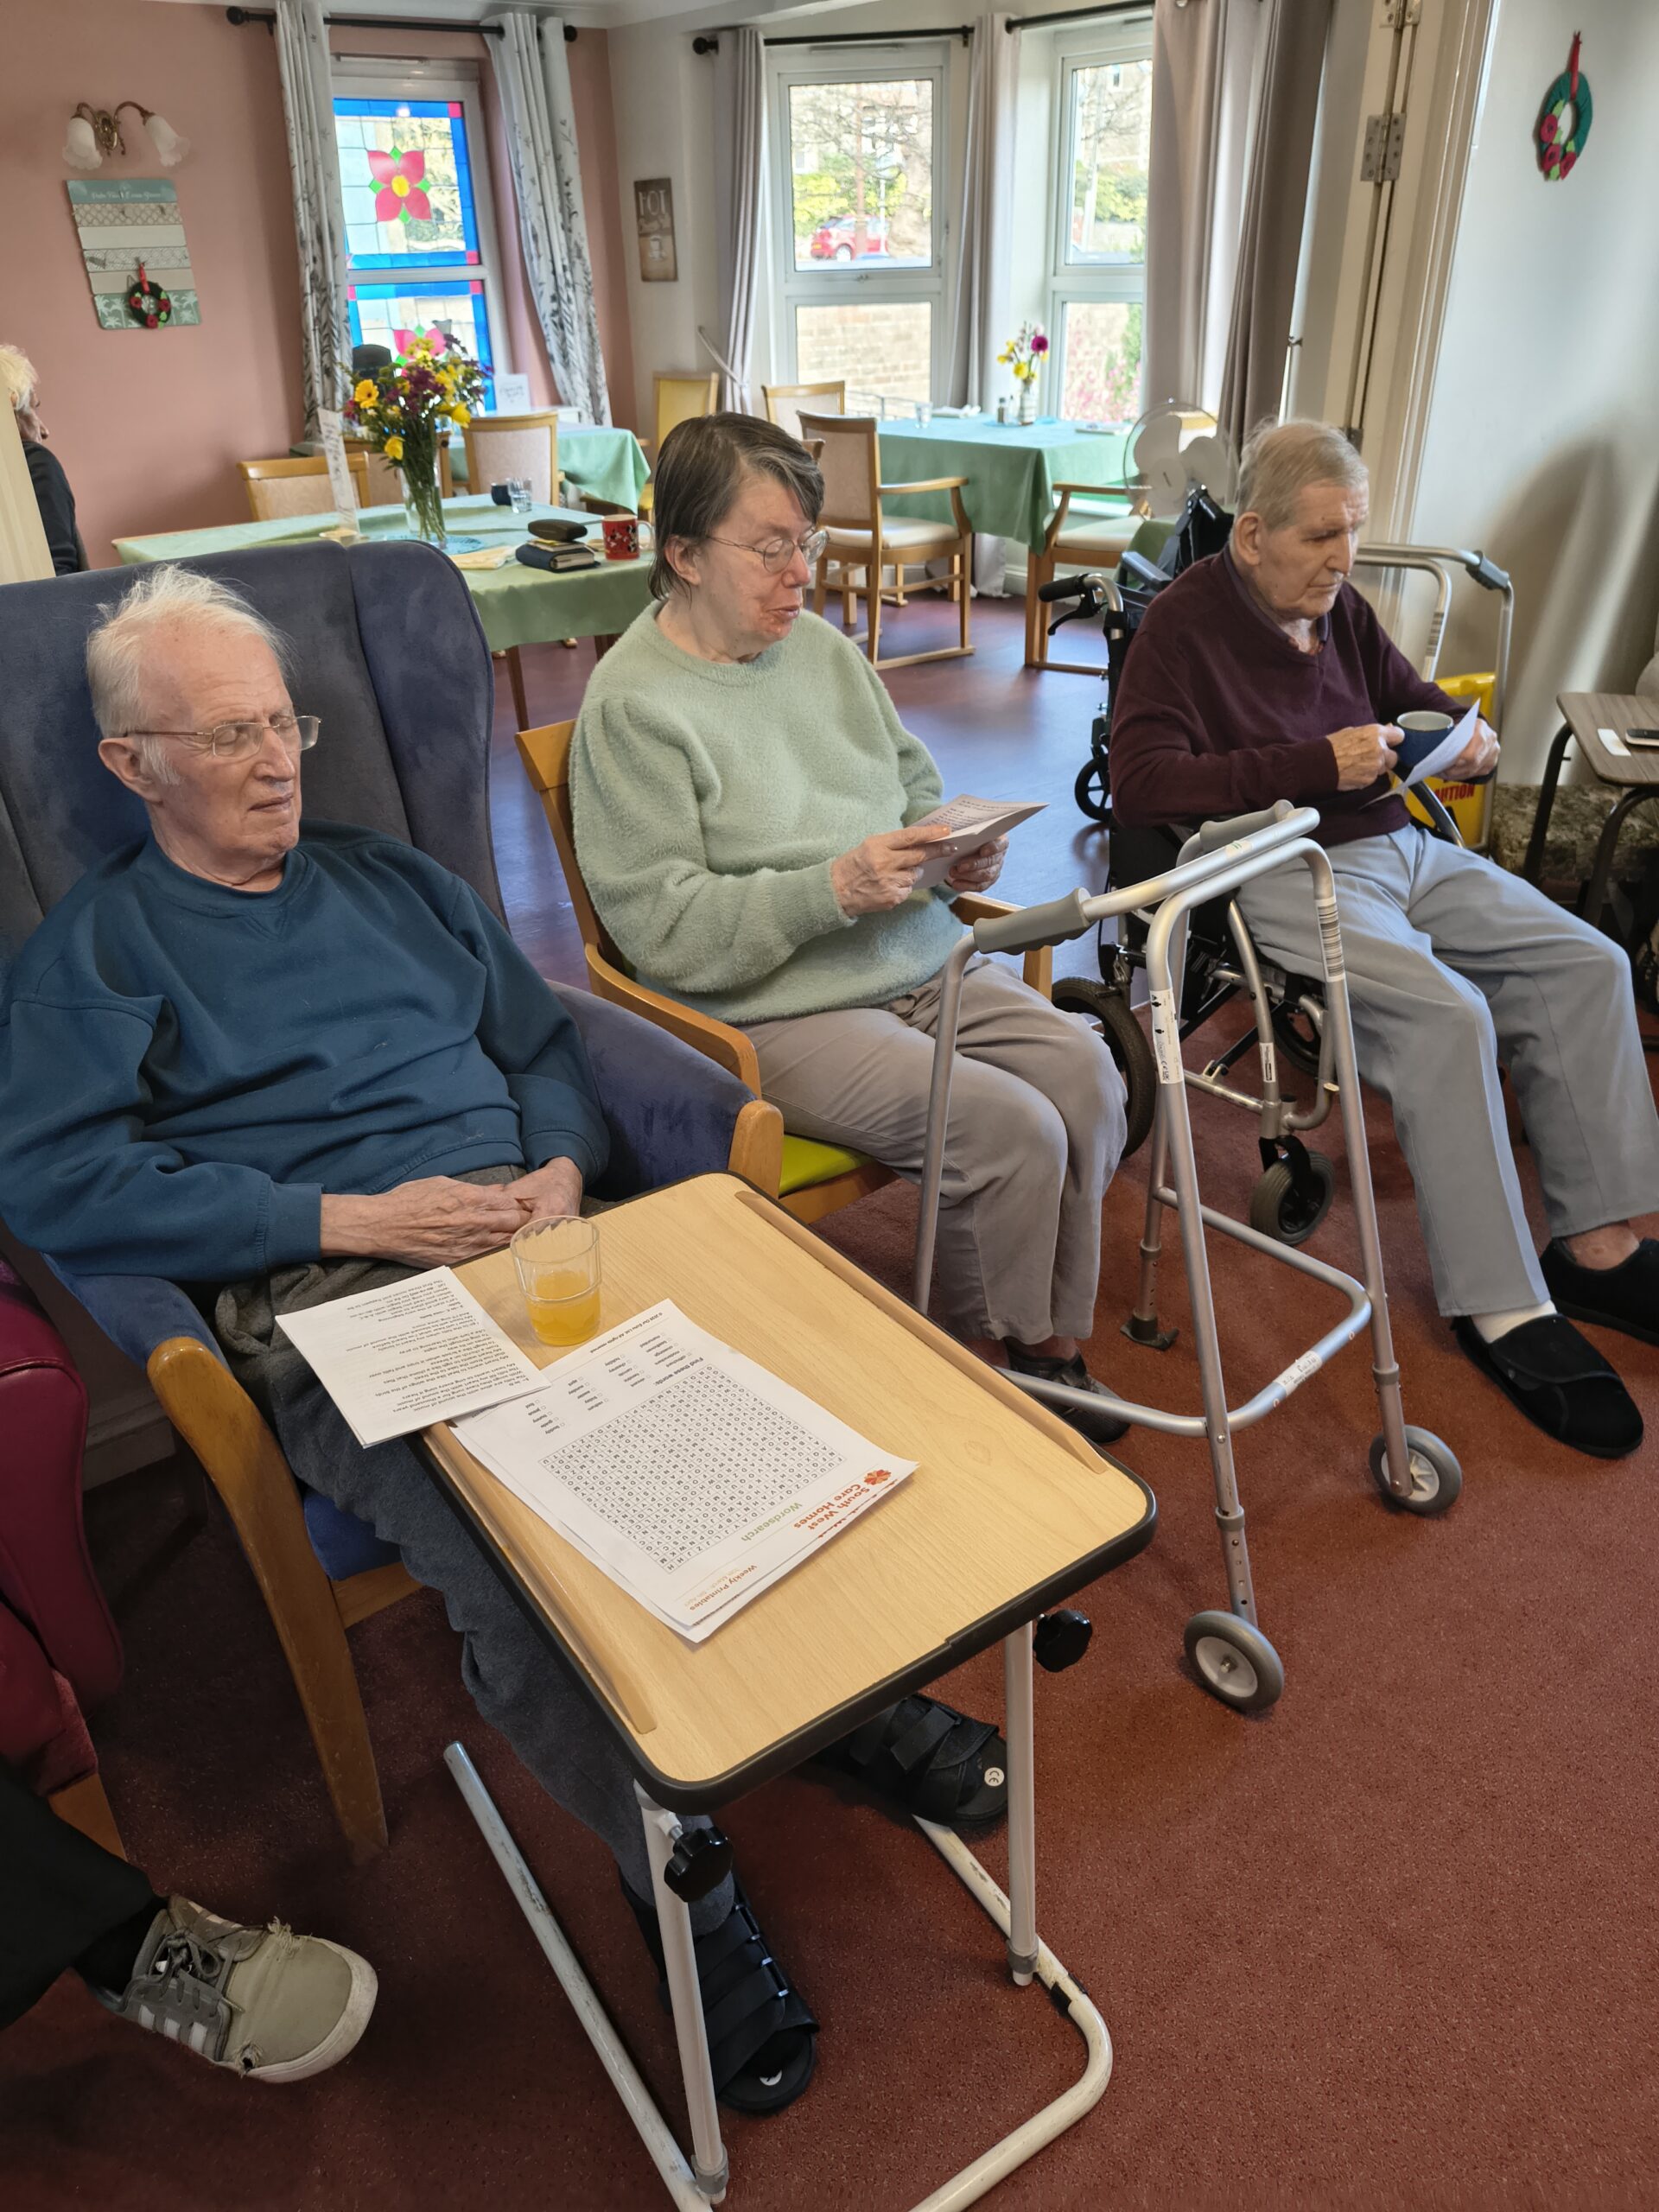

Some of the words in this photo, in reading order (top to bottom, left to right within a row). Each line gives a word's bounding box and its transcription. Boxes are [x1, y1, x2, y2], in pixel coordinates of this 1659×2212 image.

[1434, 784, 1475, 802] AUTION
[673, 1364, 690, 1375] these
[689, 1357, 703, 1366] Find
[834, 1484, 861, 1501] Care
[836, 1487, 869, 1509] South
[741, 1503, 802, 1541] Wordsearch
[793, 1502, 835, 1528] Homes
[807, 1510, 838, 1529] West
[728, 1565, 757, 1584] Weekly
[690, 1584, 729, 1610] Printables
